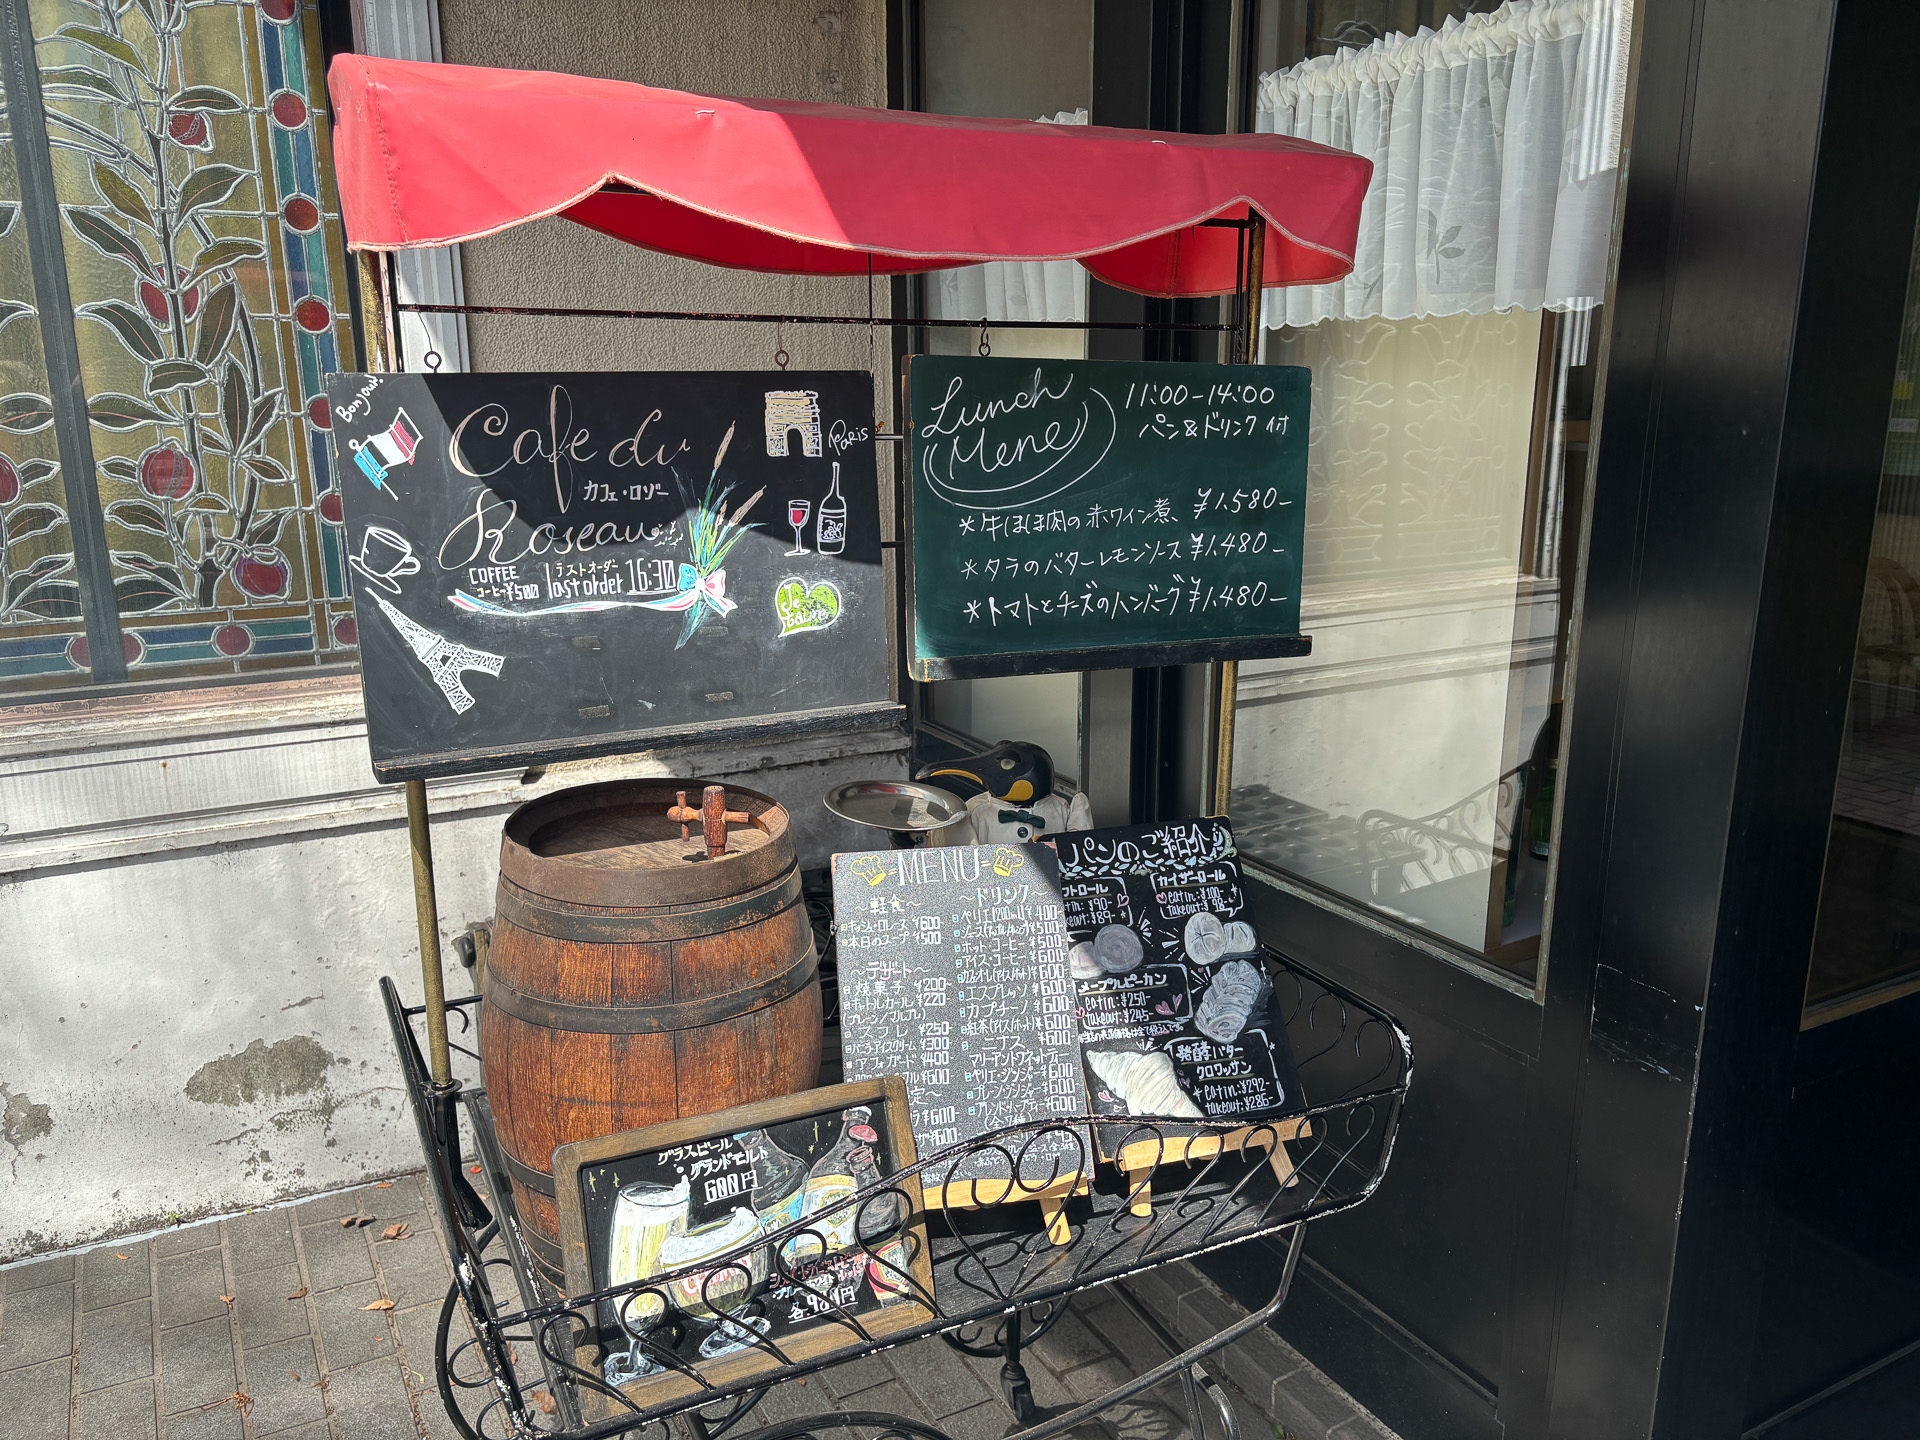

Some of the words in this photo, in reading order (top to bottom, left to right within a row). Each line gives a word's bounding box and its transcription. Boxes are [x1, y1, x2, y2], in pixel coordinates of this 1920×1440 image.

[921, 368, 1073, 438] Lunch
[449, 384, 598, 514] Cafe
[608, 409, 690, 467] du
[583, 480, 669, 502] カフェ・ロゾー
[436, 488, 656, 570] Roseau
[469, 565, 519, 586] COFFEE
[555, 558, 619, 578] ラストオーダー
[625, 557, 677, 592] 16:30
[781, 584, 800, 613] Je
[1066, 823, 1210, 868] パンのご紹介
[897, 849, 980, 886] MENU
[1157, 869, 1226, 887] カイザーロール
[848, 931, 910, 948] 本日のスープ
[855, 980, 905, 996] 焼菓子
[966, 983, 1027, 1001] エスプレッソ
[1078, 973, 1167, 992] メープルピーカン
[967, 1000, 1028, 1020] カプチーノ
[859, 1024, 908, 1039] スフレ
[982, 1035, 1026, 1050] ニナス
[1196, 1059, 1252, 1080] クロワッサン
[657, 1138, 733, 1166] グラスビール
[704, 1169, 758, 1202] 600円
